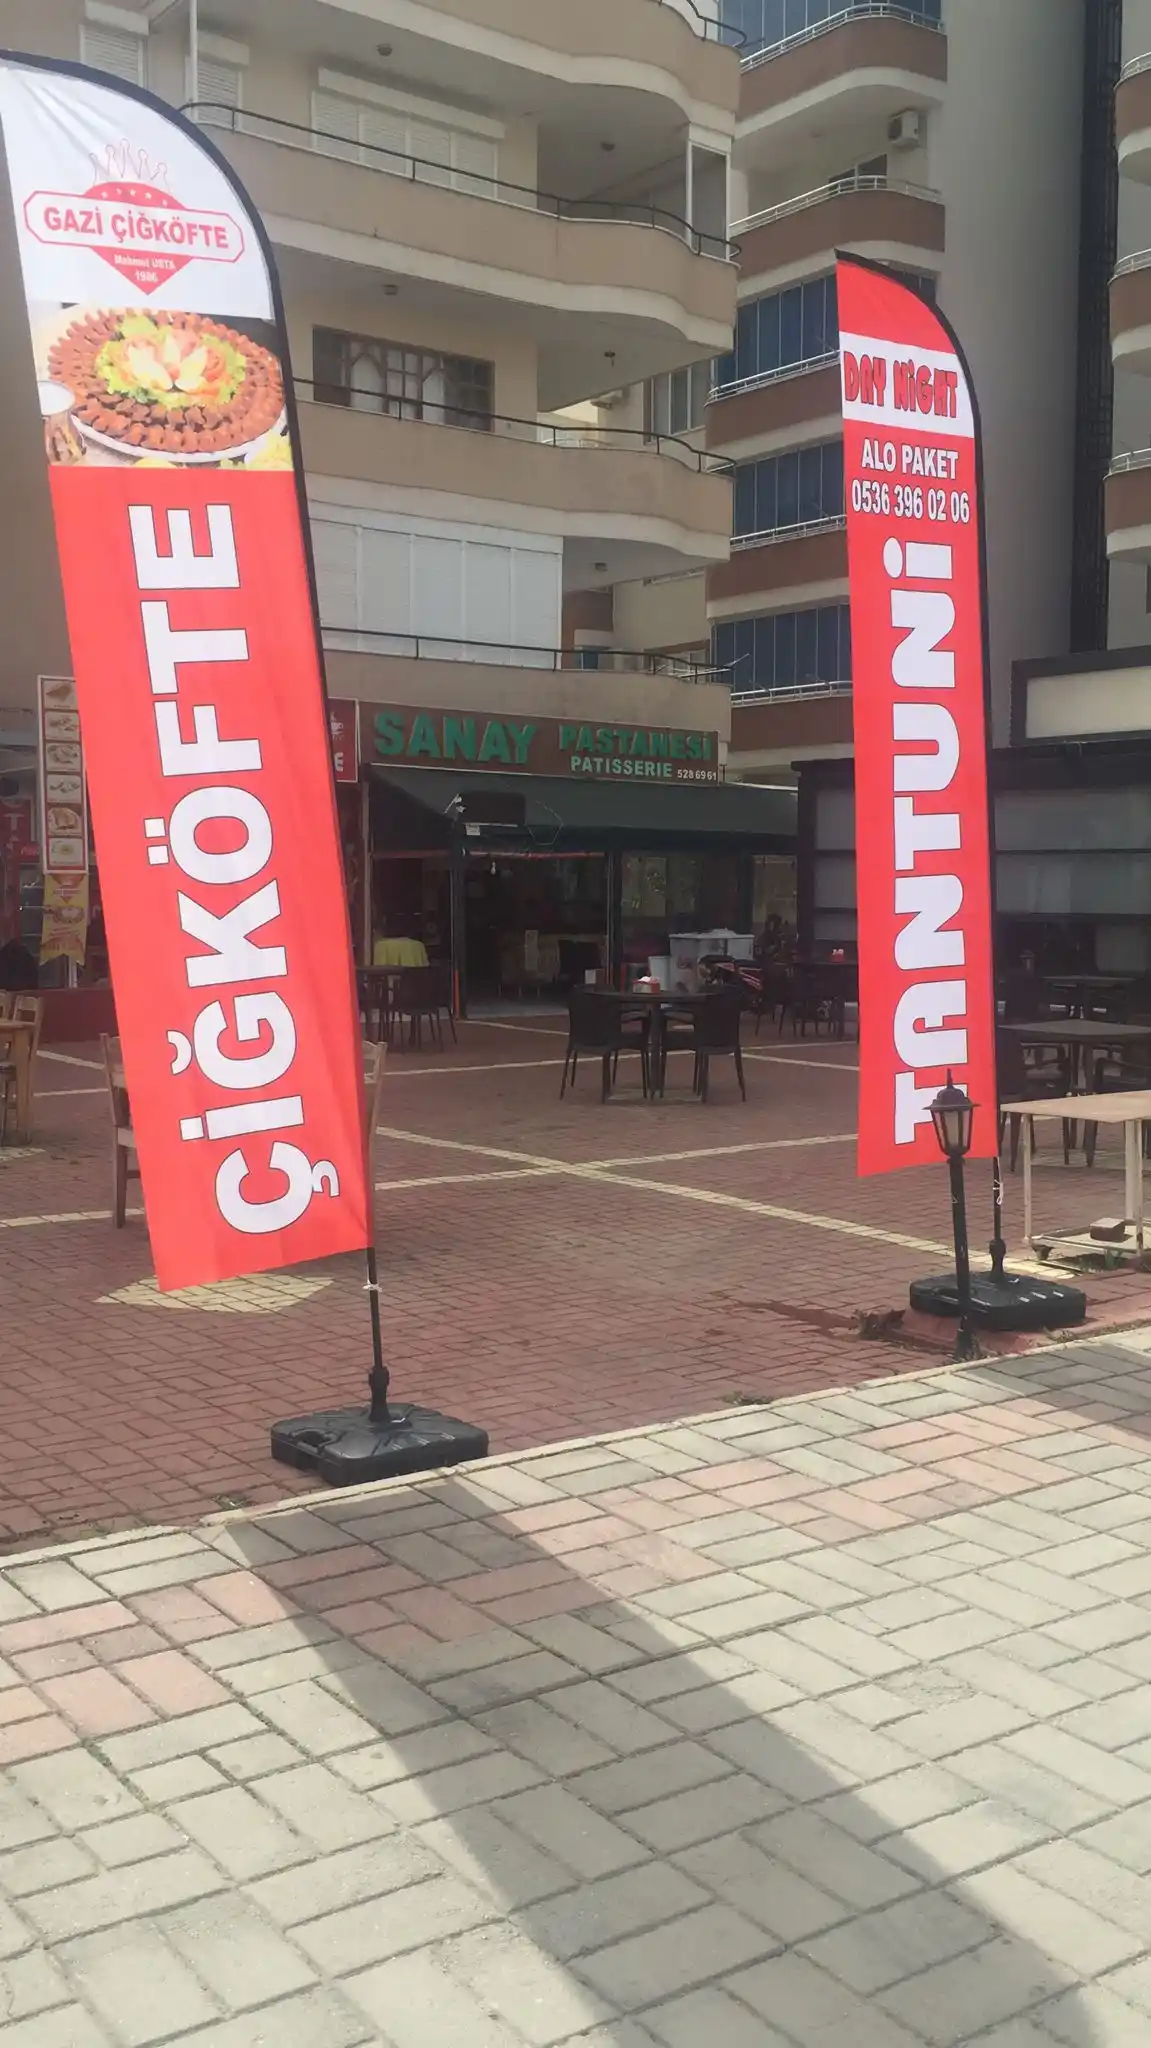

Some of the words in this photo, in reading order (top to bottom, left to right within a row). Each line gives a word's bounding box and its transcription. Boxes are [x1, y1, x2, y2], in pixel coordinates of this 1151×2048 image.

[43, 206, 103, 235] GAZİ
[110, 210, 229, 249] ÇİĞKÖFTE
[843, 350, 887, 407] DAY
[861, 438, 897, 472] ALO
[902, 444, 959, 480] PAKET
[851, 479, 891, 516] 0536
[894, 484, 924, 519] 396
[927, 488, 948, 521] 02
[950, 491, 970, 524] 06
[373, 709, 536, 764] SANAY
[570, 756, 673, 777] PATISSERIE
[127, 503, 341, 1235] ÇİĞKÖFTE
